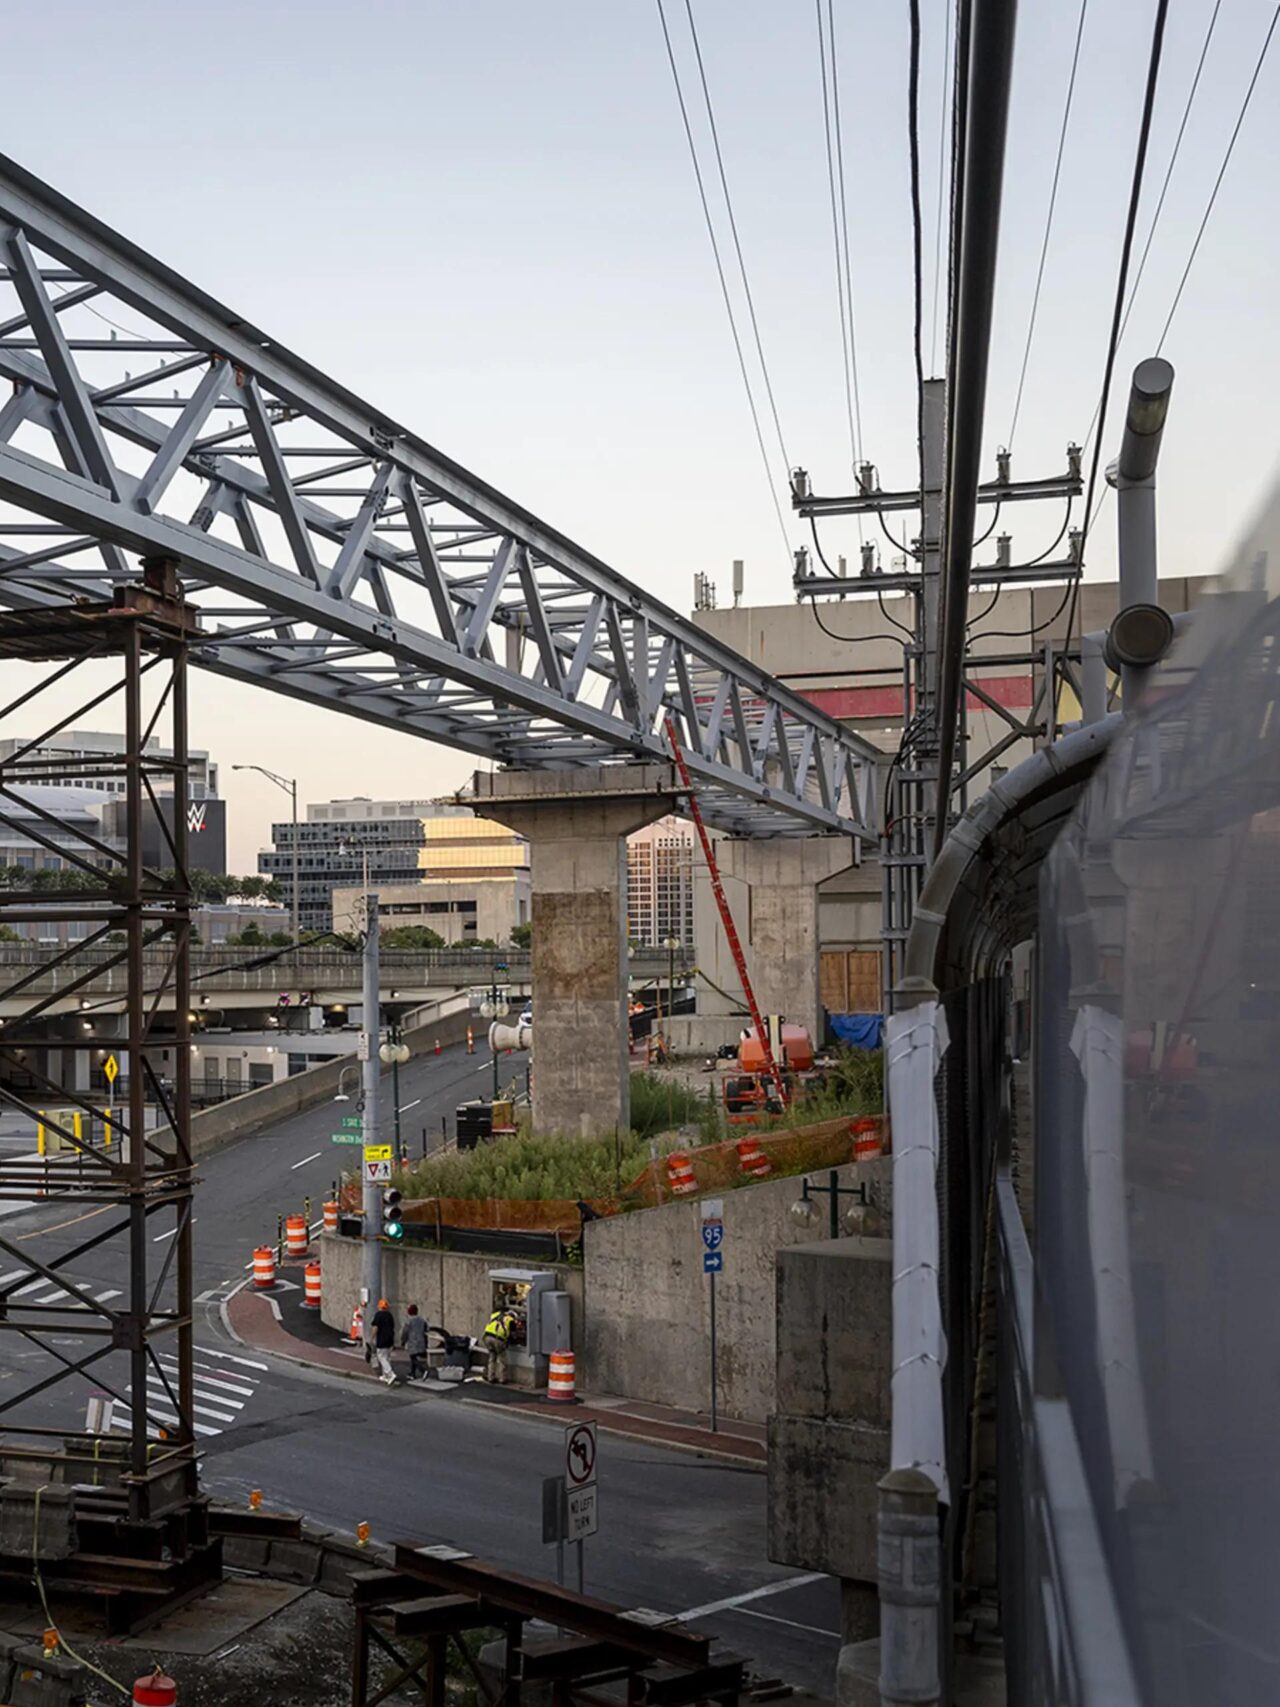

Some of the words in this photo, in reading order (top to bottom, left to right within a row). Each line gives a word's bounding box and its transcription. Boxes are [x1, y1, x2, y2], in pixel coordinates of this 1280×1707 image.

[705, 1228, 721, 1244] 95
[571, 1499, 579, 1514] NO
[580, 1495, 594, 1512] LEFT
[574, 1515, 590, 1530] TURN
